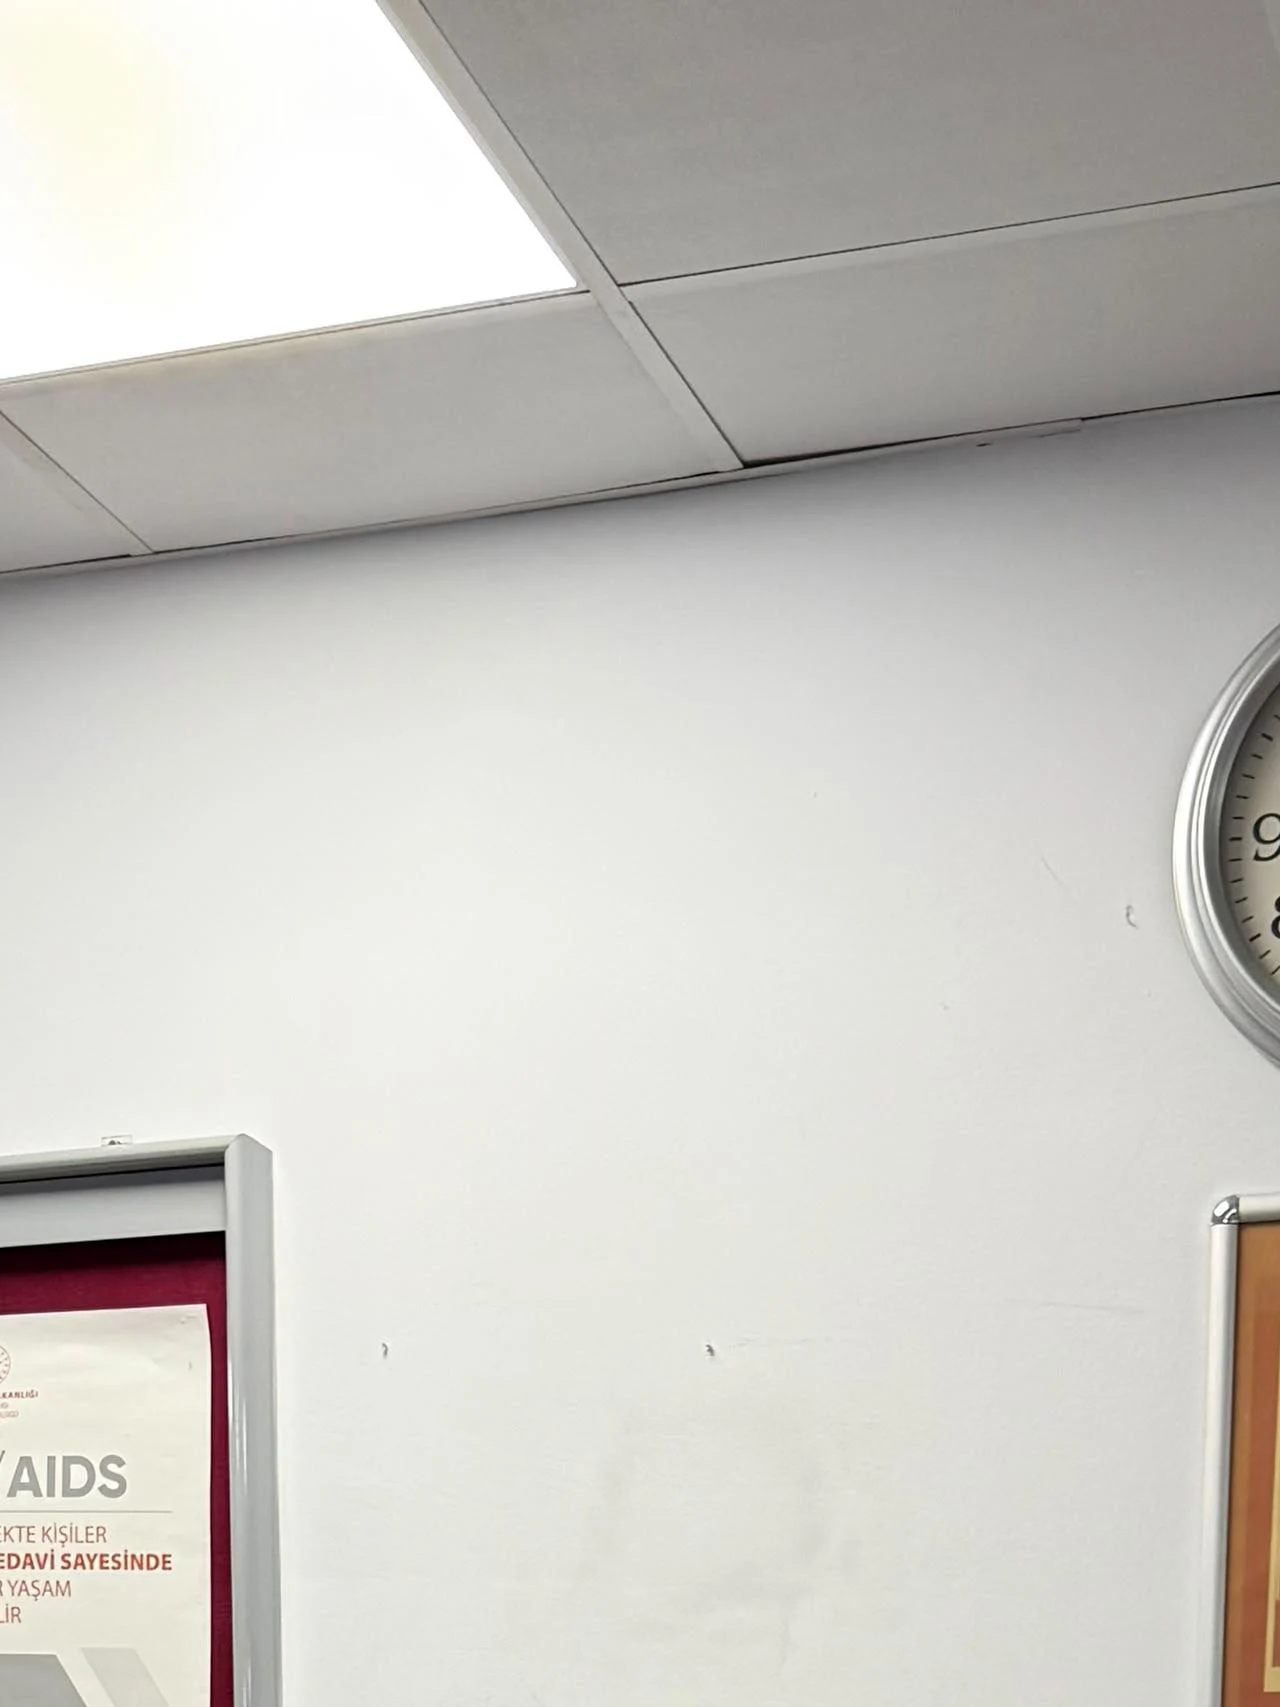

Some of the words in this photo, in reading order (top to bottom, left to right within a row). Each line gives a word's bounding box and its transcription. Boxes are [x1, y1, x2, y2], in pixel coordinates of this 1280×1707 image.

[41, 1522, 107, 1548] KİŞİLER
[60, 1549, 173, 1571] SAYESİNDE
[8, 1579, 72, 1602] YAŞAM
